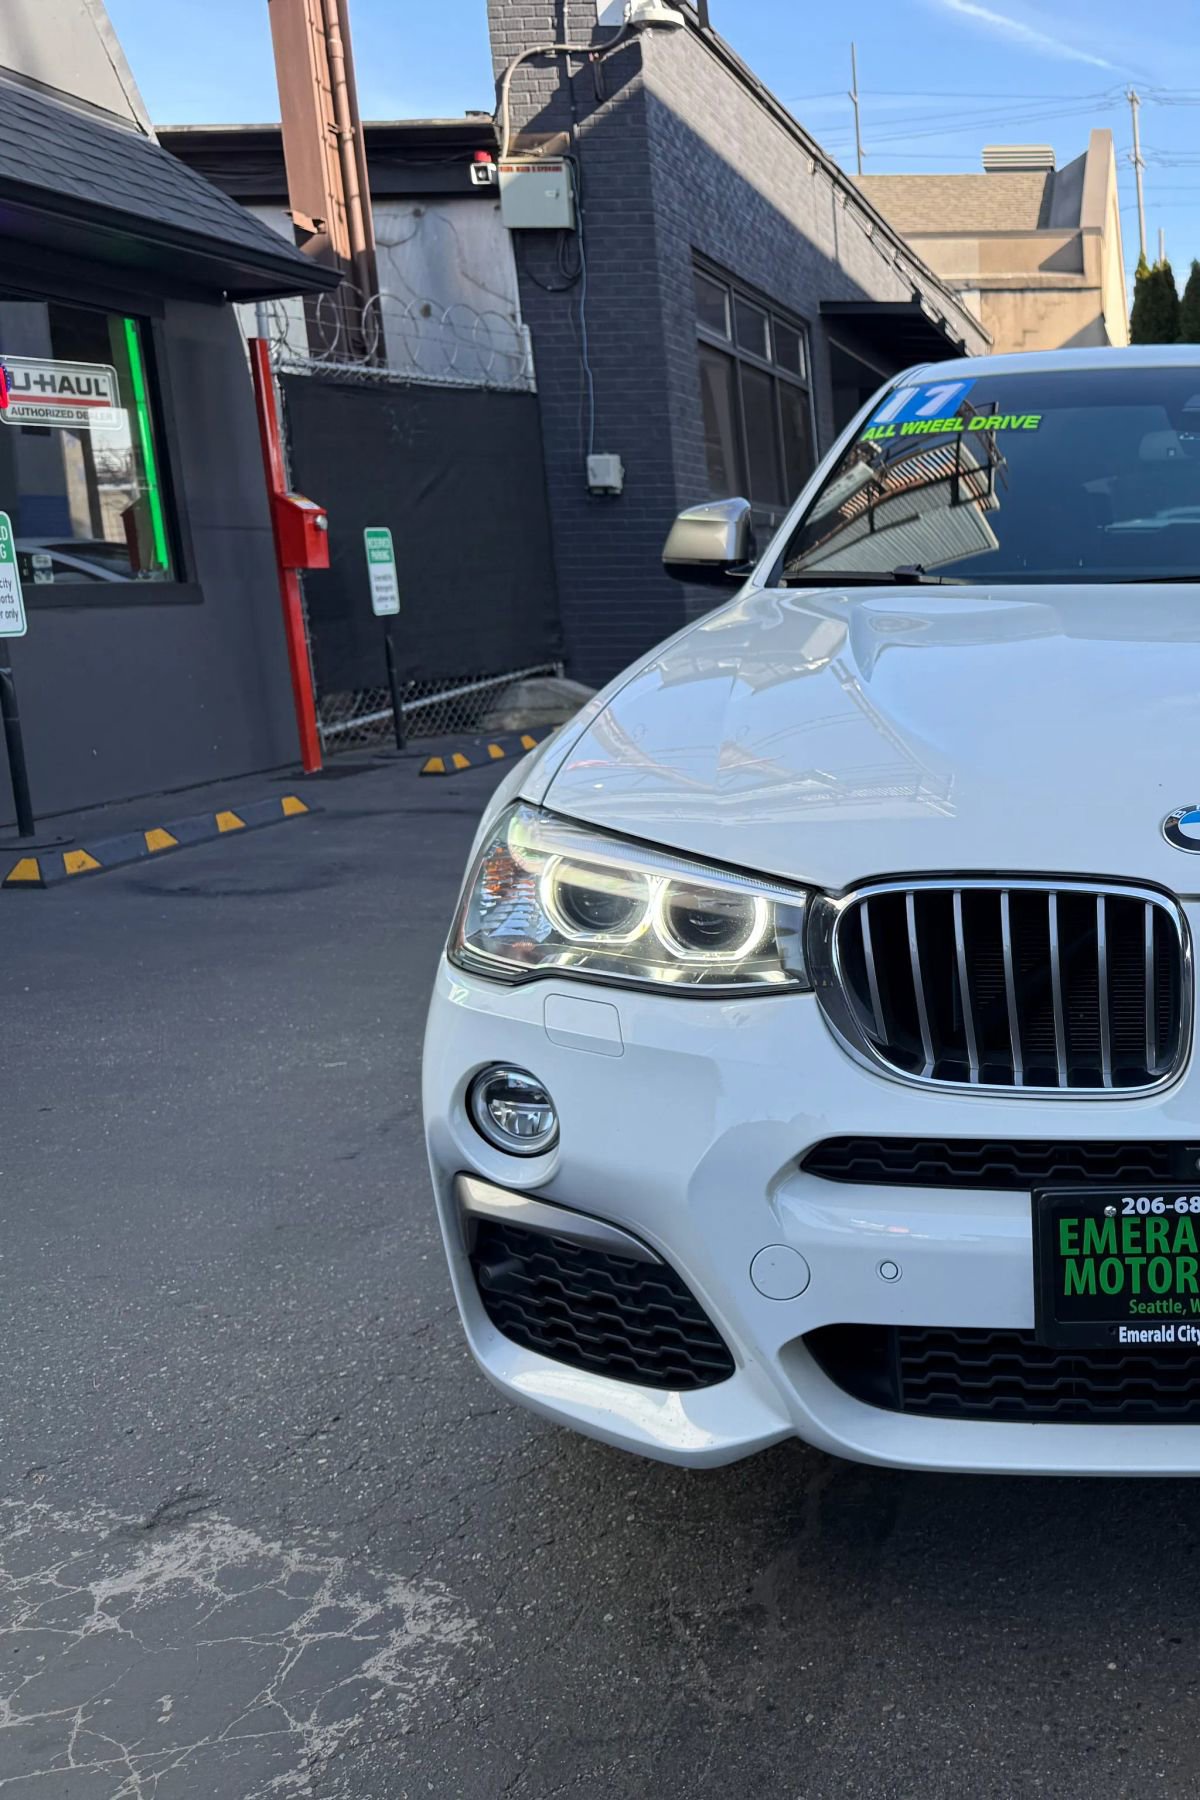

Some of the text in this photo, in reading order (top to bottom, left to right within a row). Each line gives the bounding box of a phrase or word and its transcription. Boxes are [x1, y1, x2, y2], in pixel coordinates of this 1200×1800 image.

[8, 371, 108, 397] U-HAUL
[11, 407, 74, 419] AUTHORIZED
[873, 382, 966, 423] 17
[860, 414, 1043, 442] ALL WHEEL DRIVE
[1128, 1298, 1188, 1316] Seattle,
[1118, 1325, 1175, 1344] Emerald
